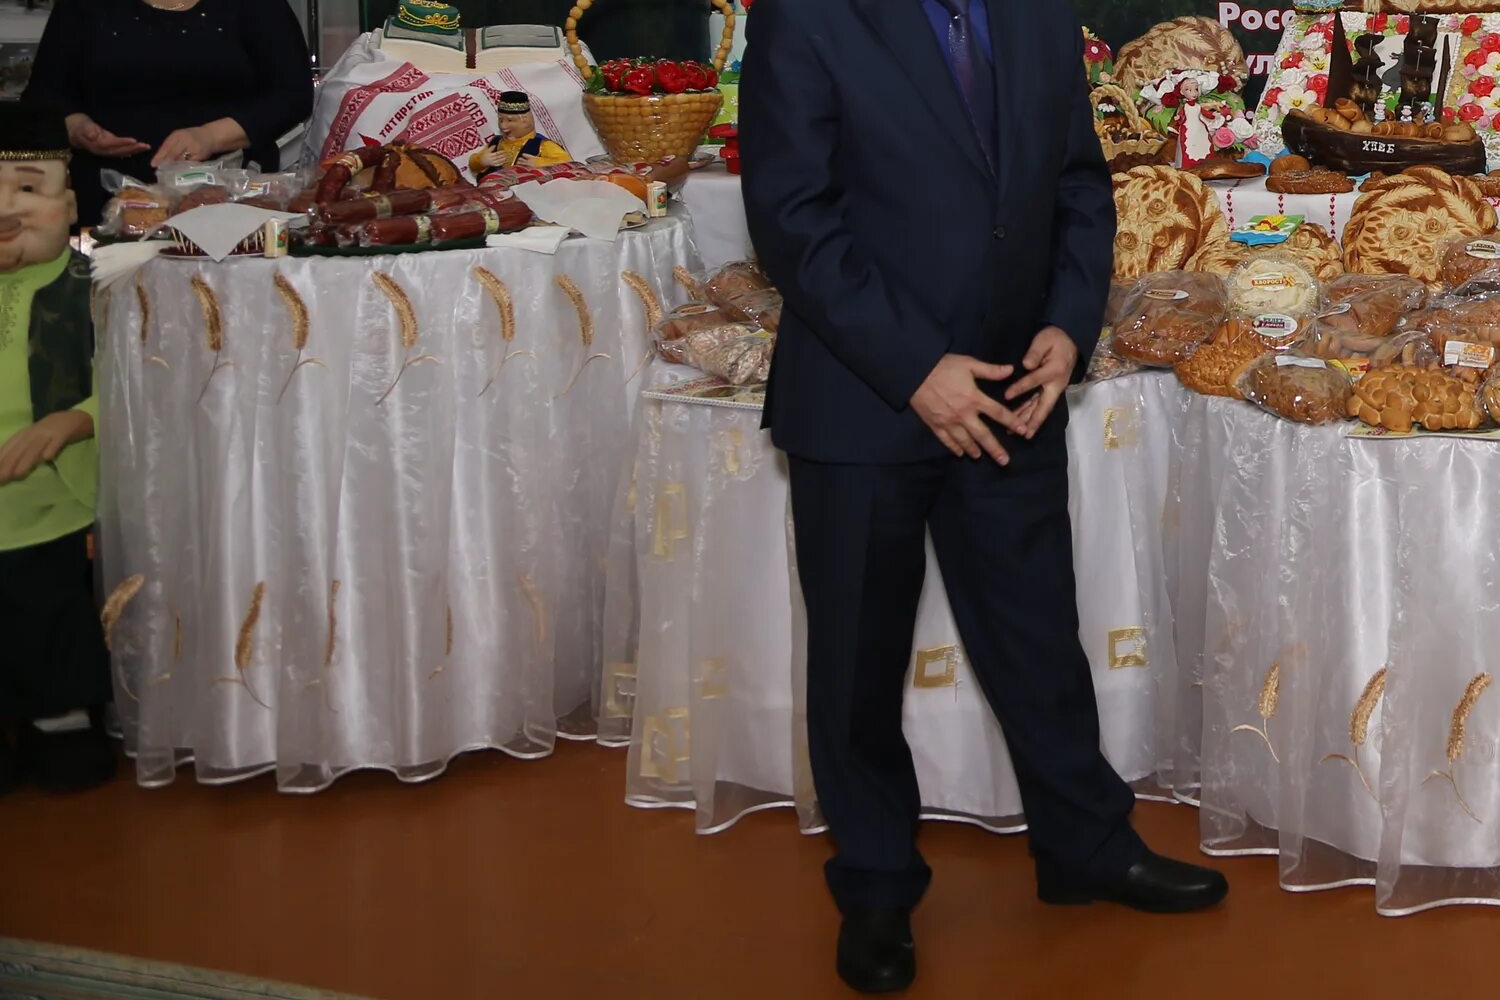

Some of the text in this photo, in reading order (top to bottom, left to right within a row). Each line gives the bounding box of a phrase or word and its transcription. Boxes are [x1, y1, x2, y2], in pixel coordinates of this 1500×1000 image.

[1218, 1, 1297, 31] Росс
[459, 92, 488, 128] ХЛЕБ
[1362, 140, 1396, 154] ХЛЕБ
